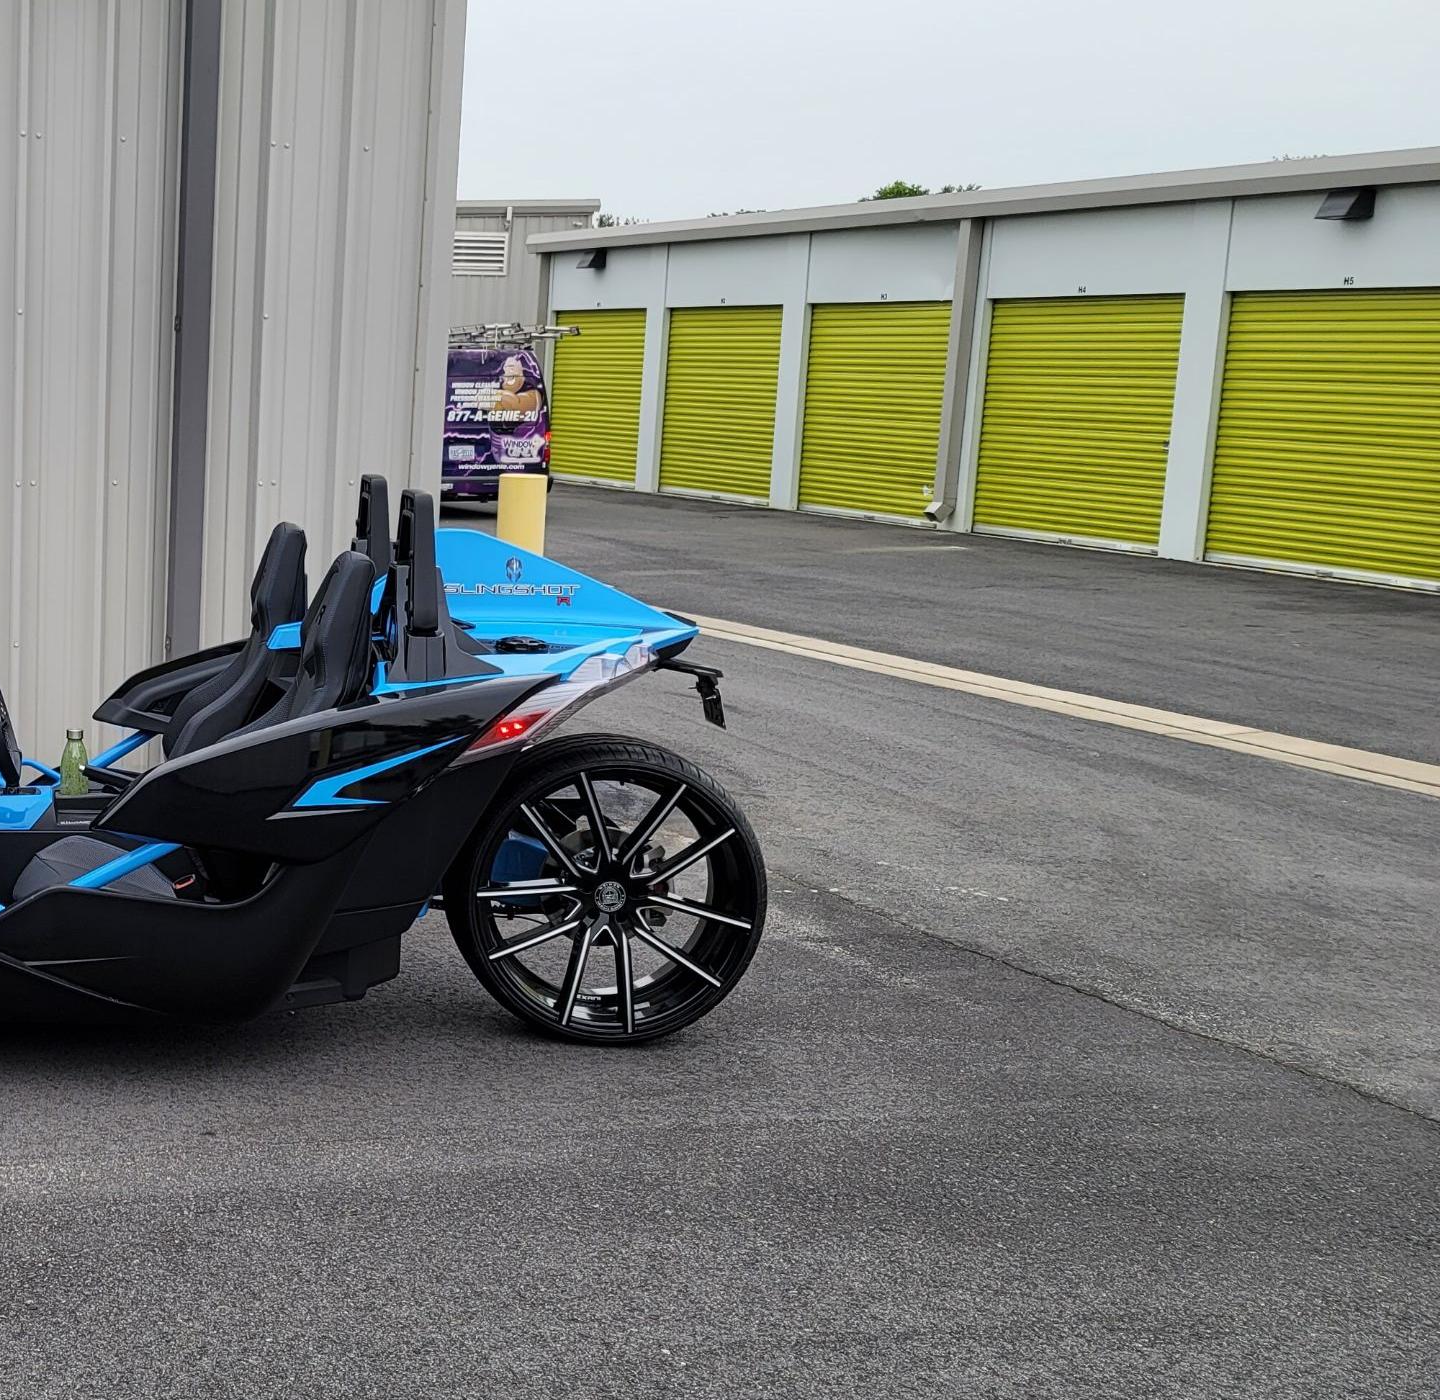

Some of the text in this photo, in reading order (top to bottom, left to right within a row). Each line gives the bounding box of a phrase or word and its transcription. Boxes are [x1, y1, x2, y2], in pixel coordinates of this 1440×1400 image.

[1343, 276, 1355, 286] H5
[1078, 285, 1087, 294] H4
[458, 463, 525, 471] windowgenie.com
[443, 583, 580, 596] SLINGSHOT
